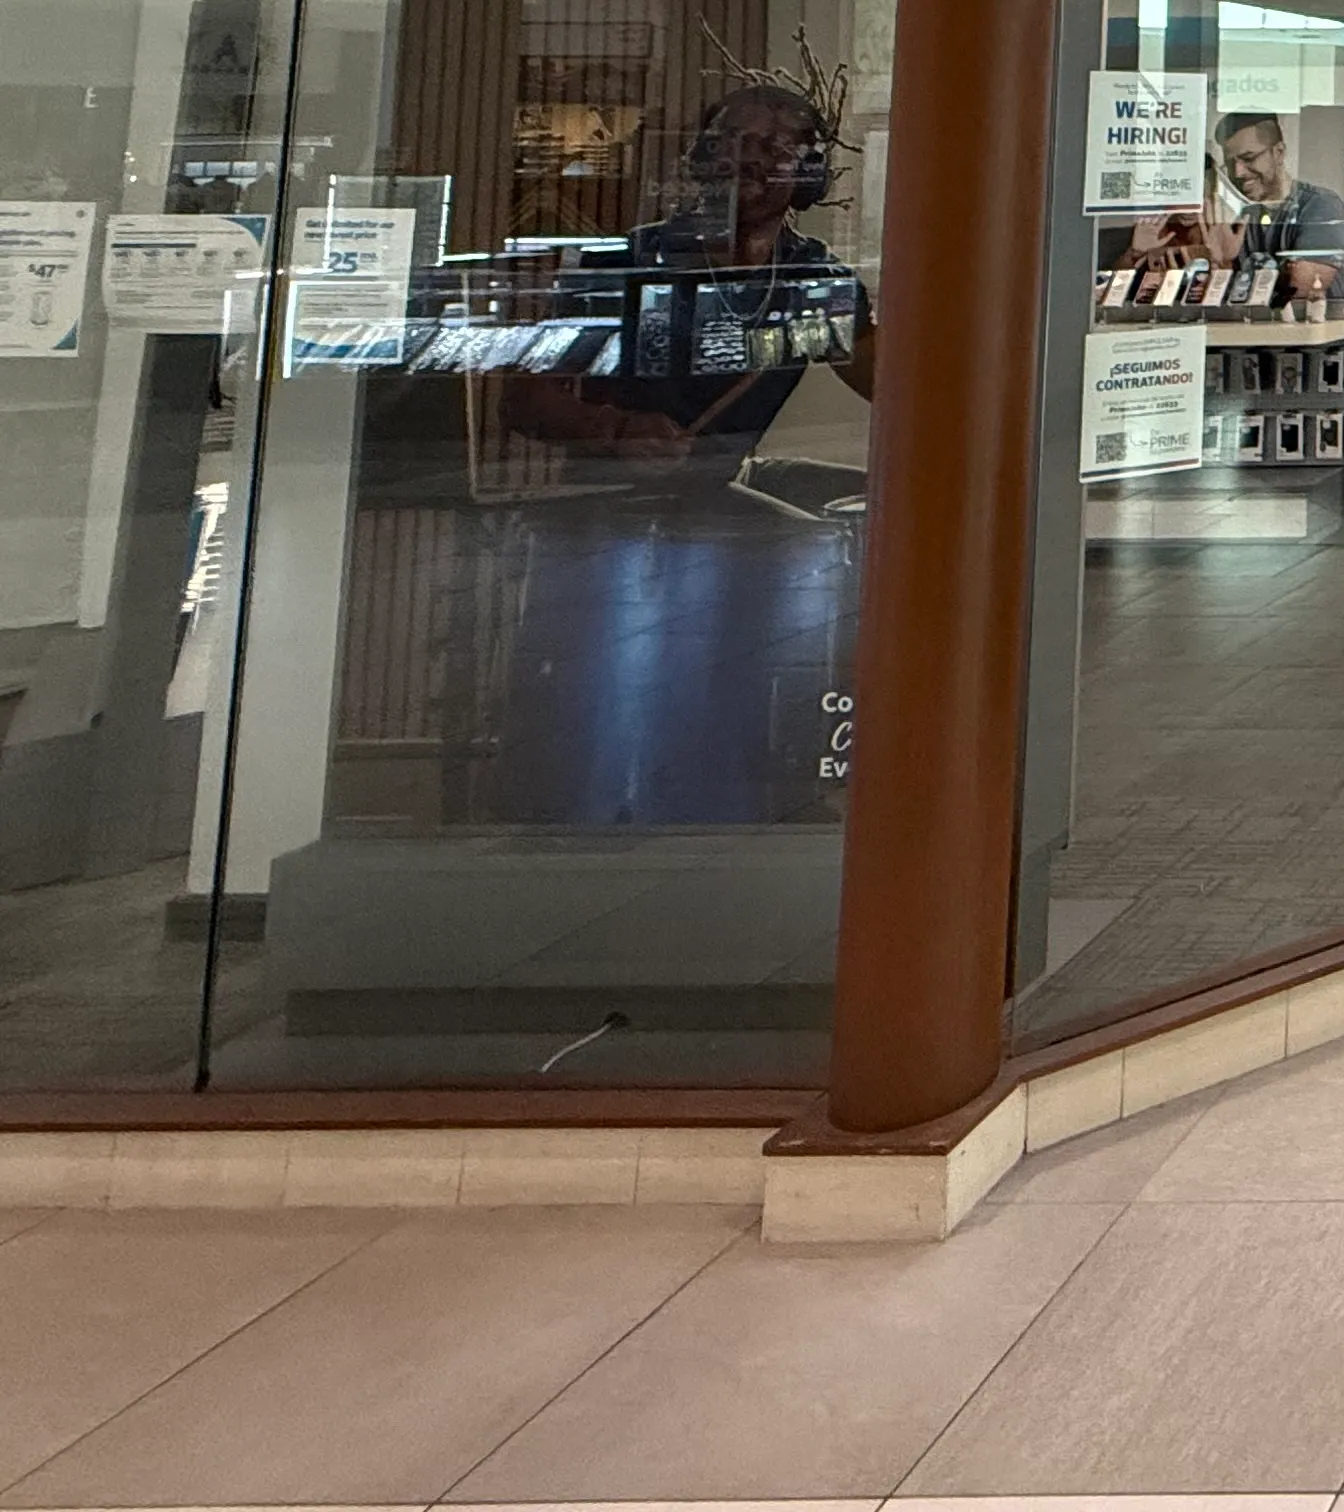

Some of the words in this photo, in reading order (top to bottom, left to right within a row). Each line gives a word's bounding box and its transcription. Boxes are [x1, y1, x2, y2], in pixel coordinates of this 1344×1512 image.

[1115, 100, 1183, 119] WE'RE
[1107, 127, 1187, 145] HIRING!
[1109, 358, 1181, 378] ¡SEGUIMOS
[1095, 371, 1194, 392] CONTRATANDO!
